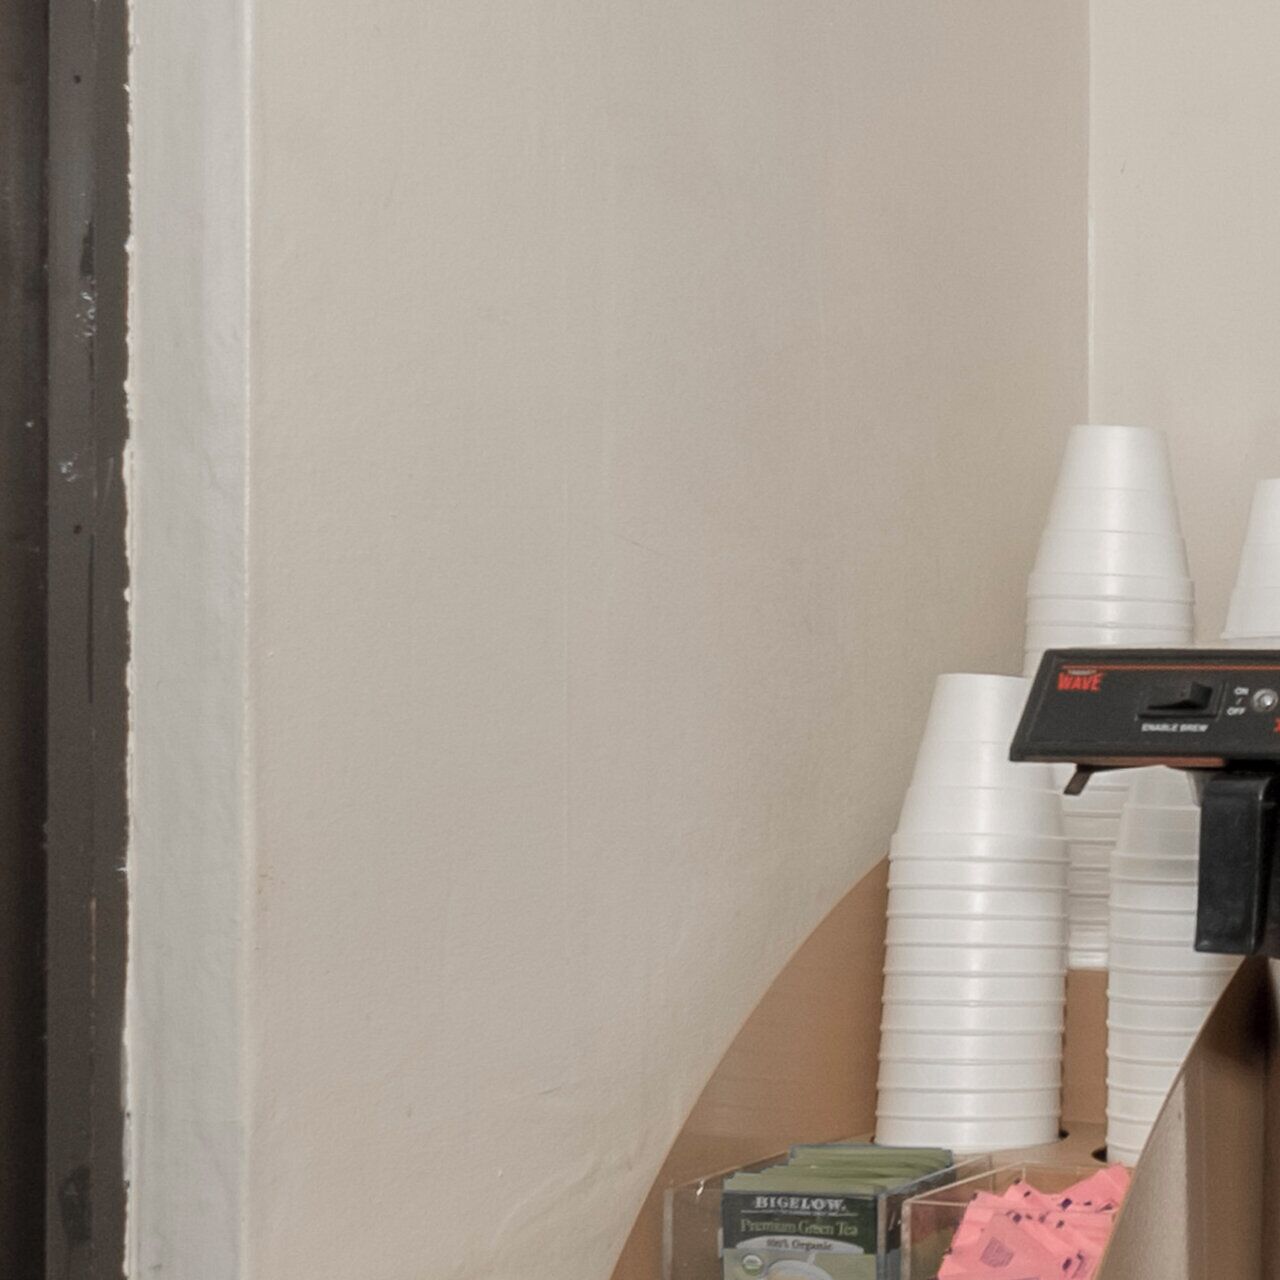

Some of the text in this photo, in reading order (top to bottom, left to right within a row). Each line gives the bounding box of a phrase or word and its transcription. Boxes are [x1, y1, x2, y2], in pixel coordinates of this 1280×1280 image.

[1057, 672, 1102, 692] WAVE
[1234, 687, 1249, 695] ON
[1226, 707, 1246, 715] OFF
[1141, 723, 1209, 732] ENABLE BREW
[754, 1196, 842, 1211] BIGELOW
[740, 1218, 859, 1236] Premium Green Tea
[792, 1239, 831, 1251] Organic
